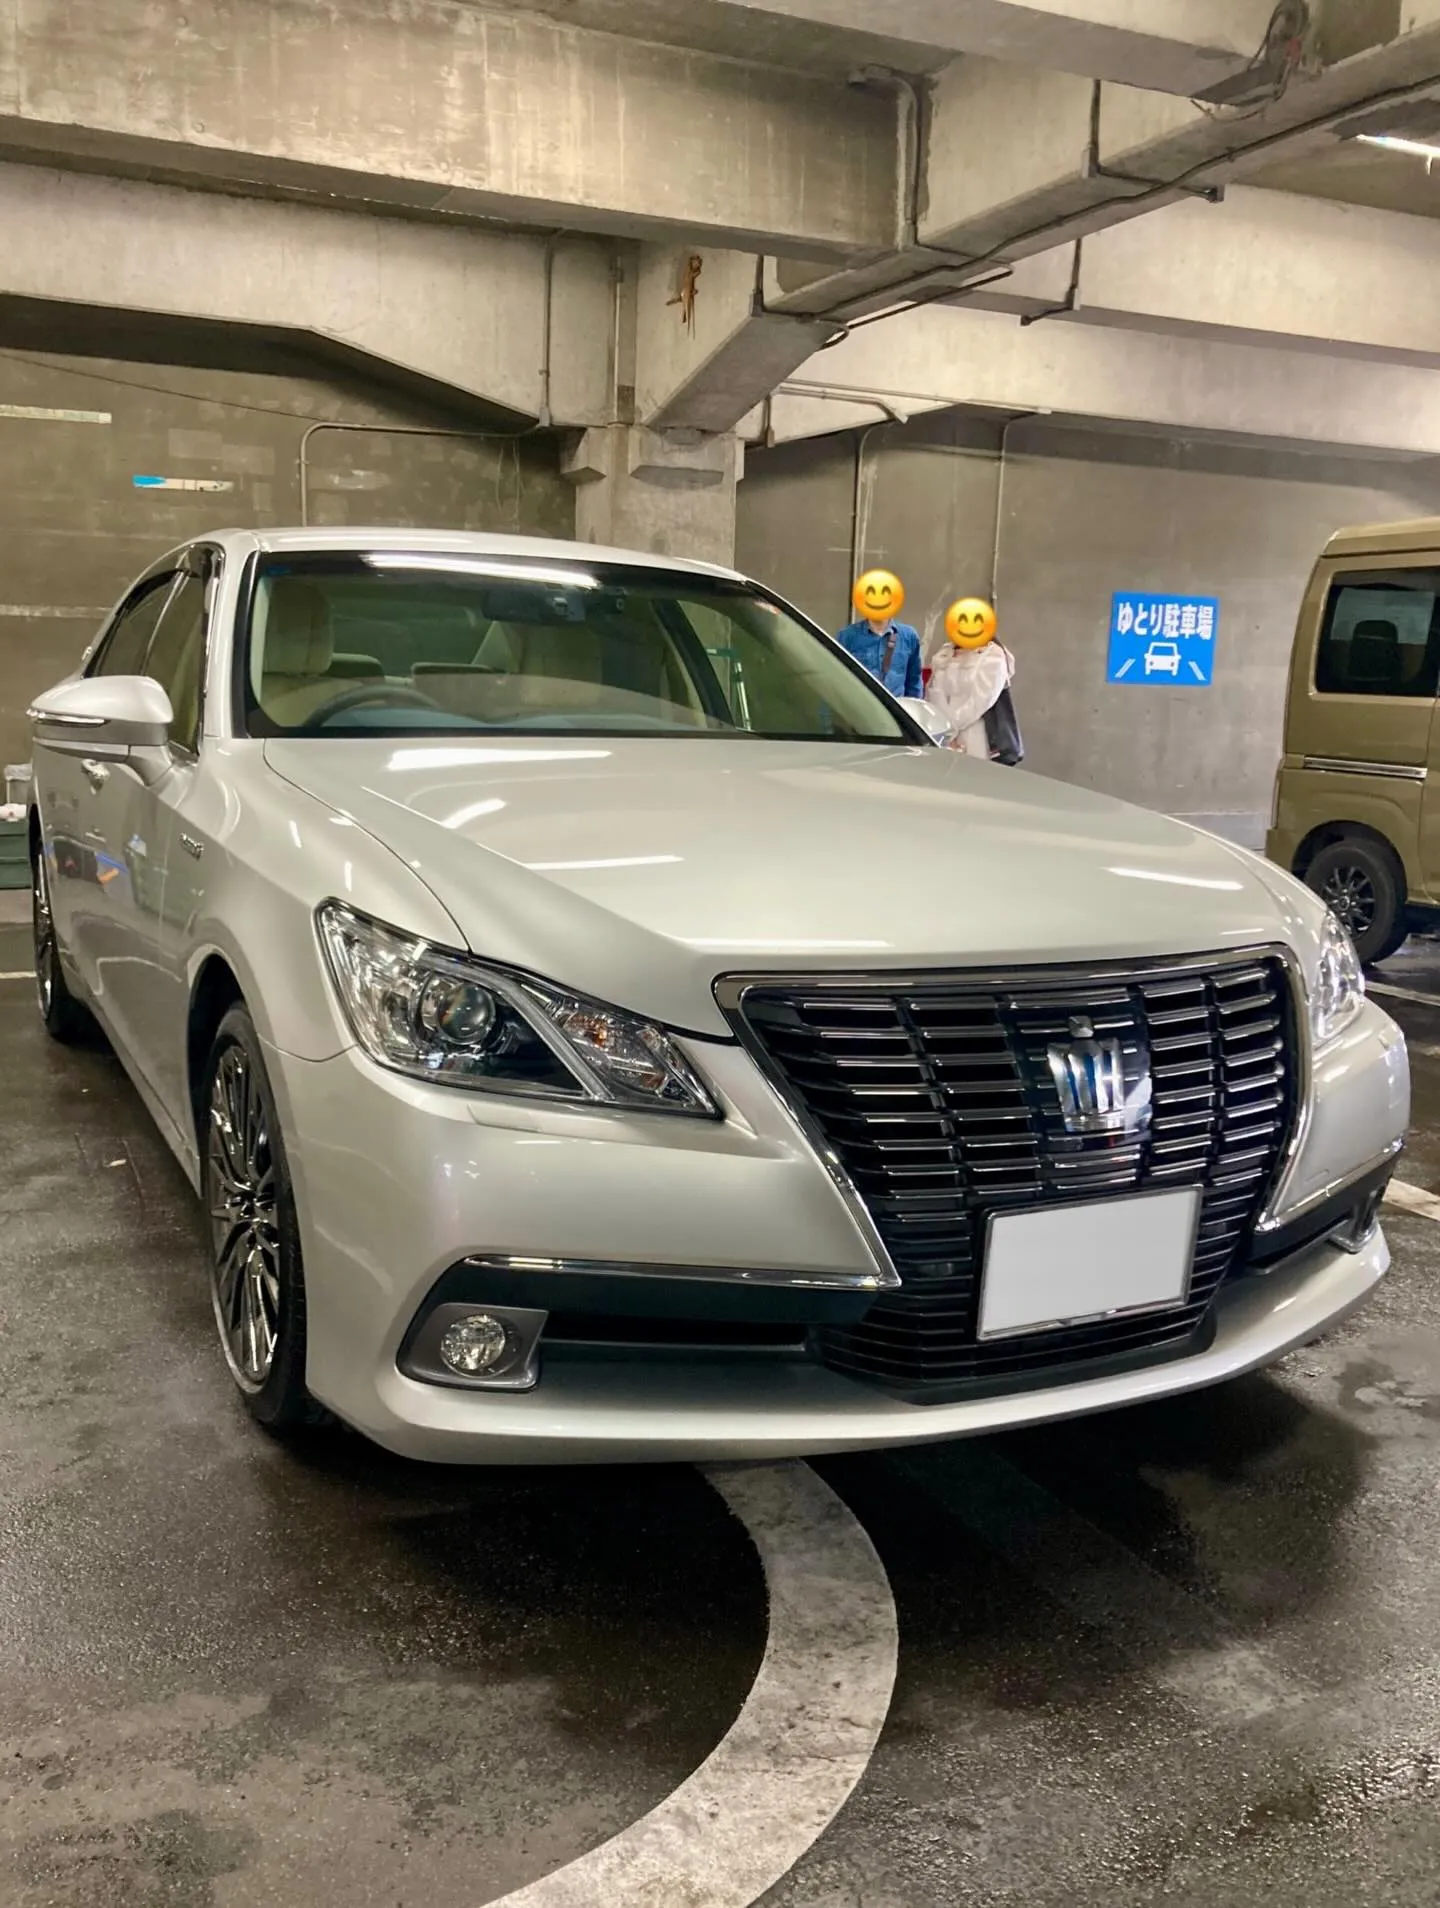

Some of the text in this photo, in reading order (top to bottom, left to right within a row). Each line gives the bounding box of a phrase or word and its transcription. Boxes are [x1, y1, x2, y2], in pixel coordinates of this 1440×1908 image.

[1117, 602, 1214, 640] ゆとり駐車場
